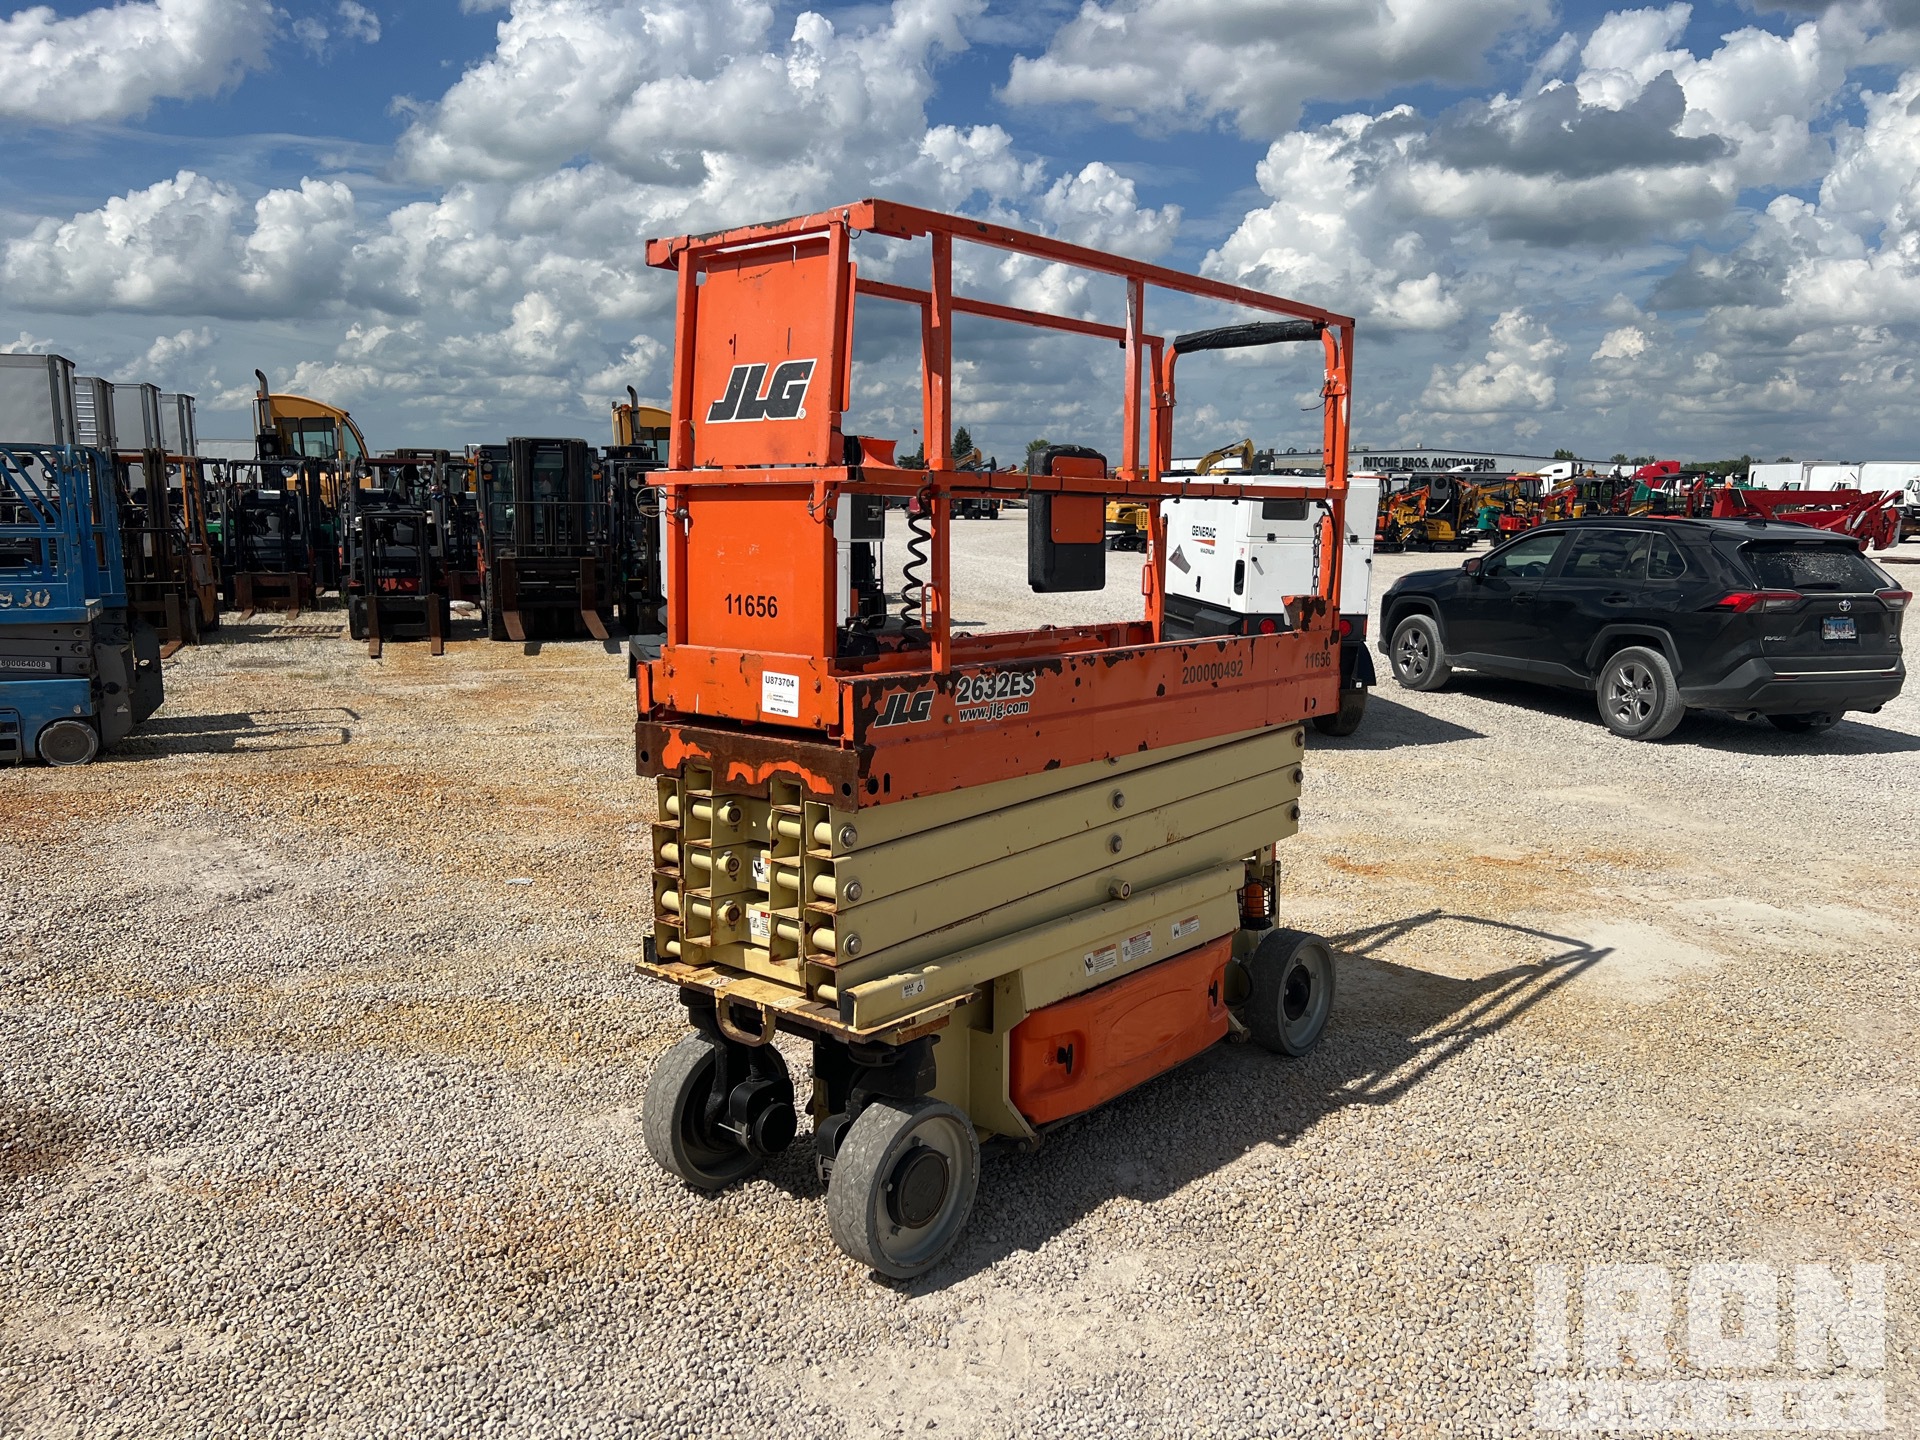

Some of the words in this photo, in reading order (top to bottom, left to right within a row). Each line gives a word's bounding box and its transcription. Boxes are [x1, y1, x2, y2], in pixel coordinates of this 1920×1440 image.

[705, 358, 817, 424] JLG
[1363, 457, 1399, 467] RITCHIE
[1402, 457, 1429, 468] BROS.
[1192, 525, 1217, 538] GENERAC
[725, 593, 778, 618] 11656
[1304, 651, 1331, 669] 11656
[765, 675, 795, 688] U873704
[1182, 660, 1244, 685] 200000492
[955, 671, 1036, 705] 2632ES
[873, 689, 935, 728] JLG
[958, 701, 1029, 722] www.jlg.com
